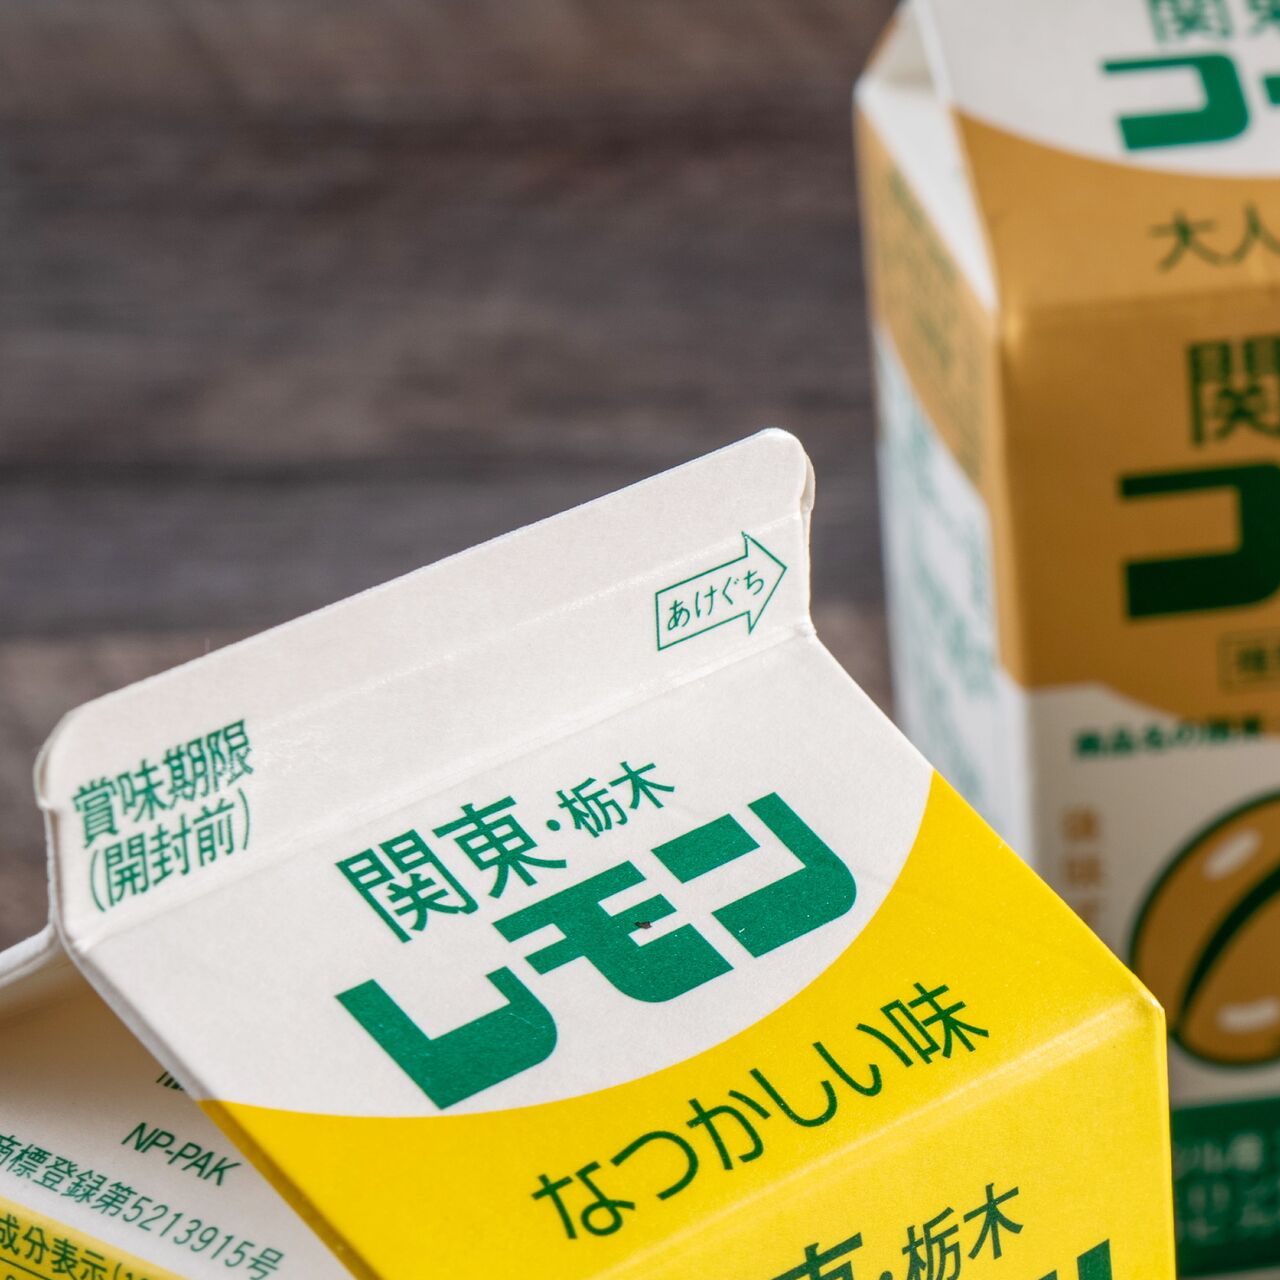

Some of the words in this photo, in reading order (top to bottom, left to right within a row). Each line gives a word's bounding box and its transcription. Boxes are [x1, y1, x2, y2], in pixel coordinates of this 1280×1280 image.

[667, 569, 765, 632] あけぐち
[70, 720, 253, 850] 賞味期限
[86, 790, 250, 911] (開封前)
[335, 761, 675, 943] 関東・栃木
[335, 792, 857, 1110] レモン
[121, 1122, 241, 1186] NP-PAK
[531, 982, 988, 1240] なつかしい味
